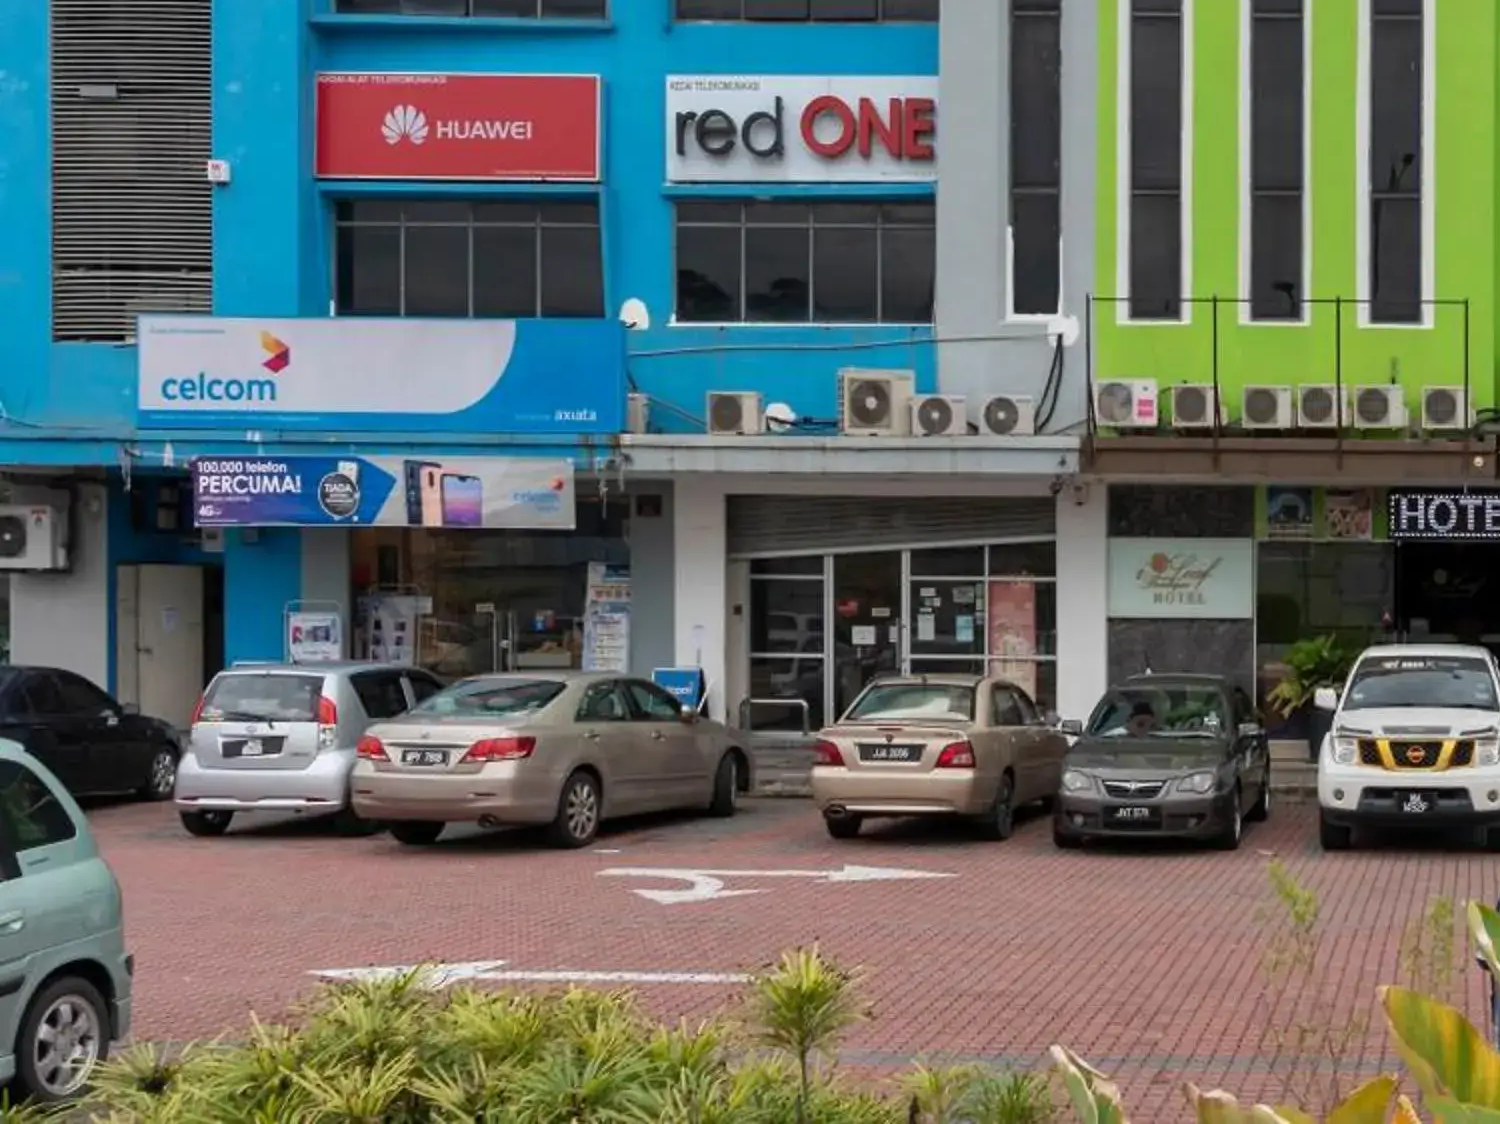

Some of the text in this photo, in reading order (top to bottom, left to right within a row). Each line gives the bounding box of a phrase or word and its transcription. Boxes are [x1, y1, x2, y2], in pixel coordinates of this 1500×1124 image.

[436, 121, 533, 139] HUAWEI
[675, 95, 936, 161] red ONE
[161, 373, 276, 401] celcom
[199, 475, 301, 494] PERCUMA!
